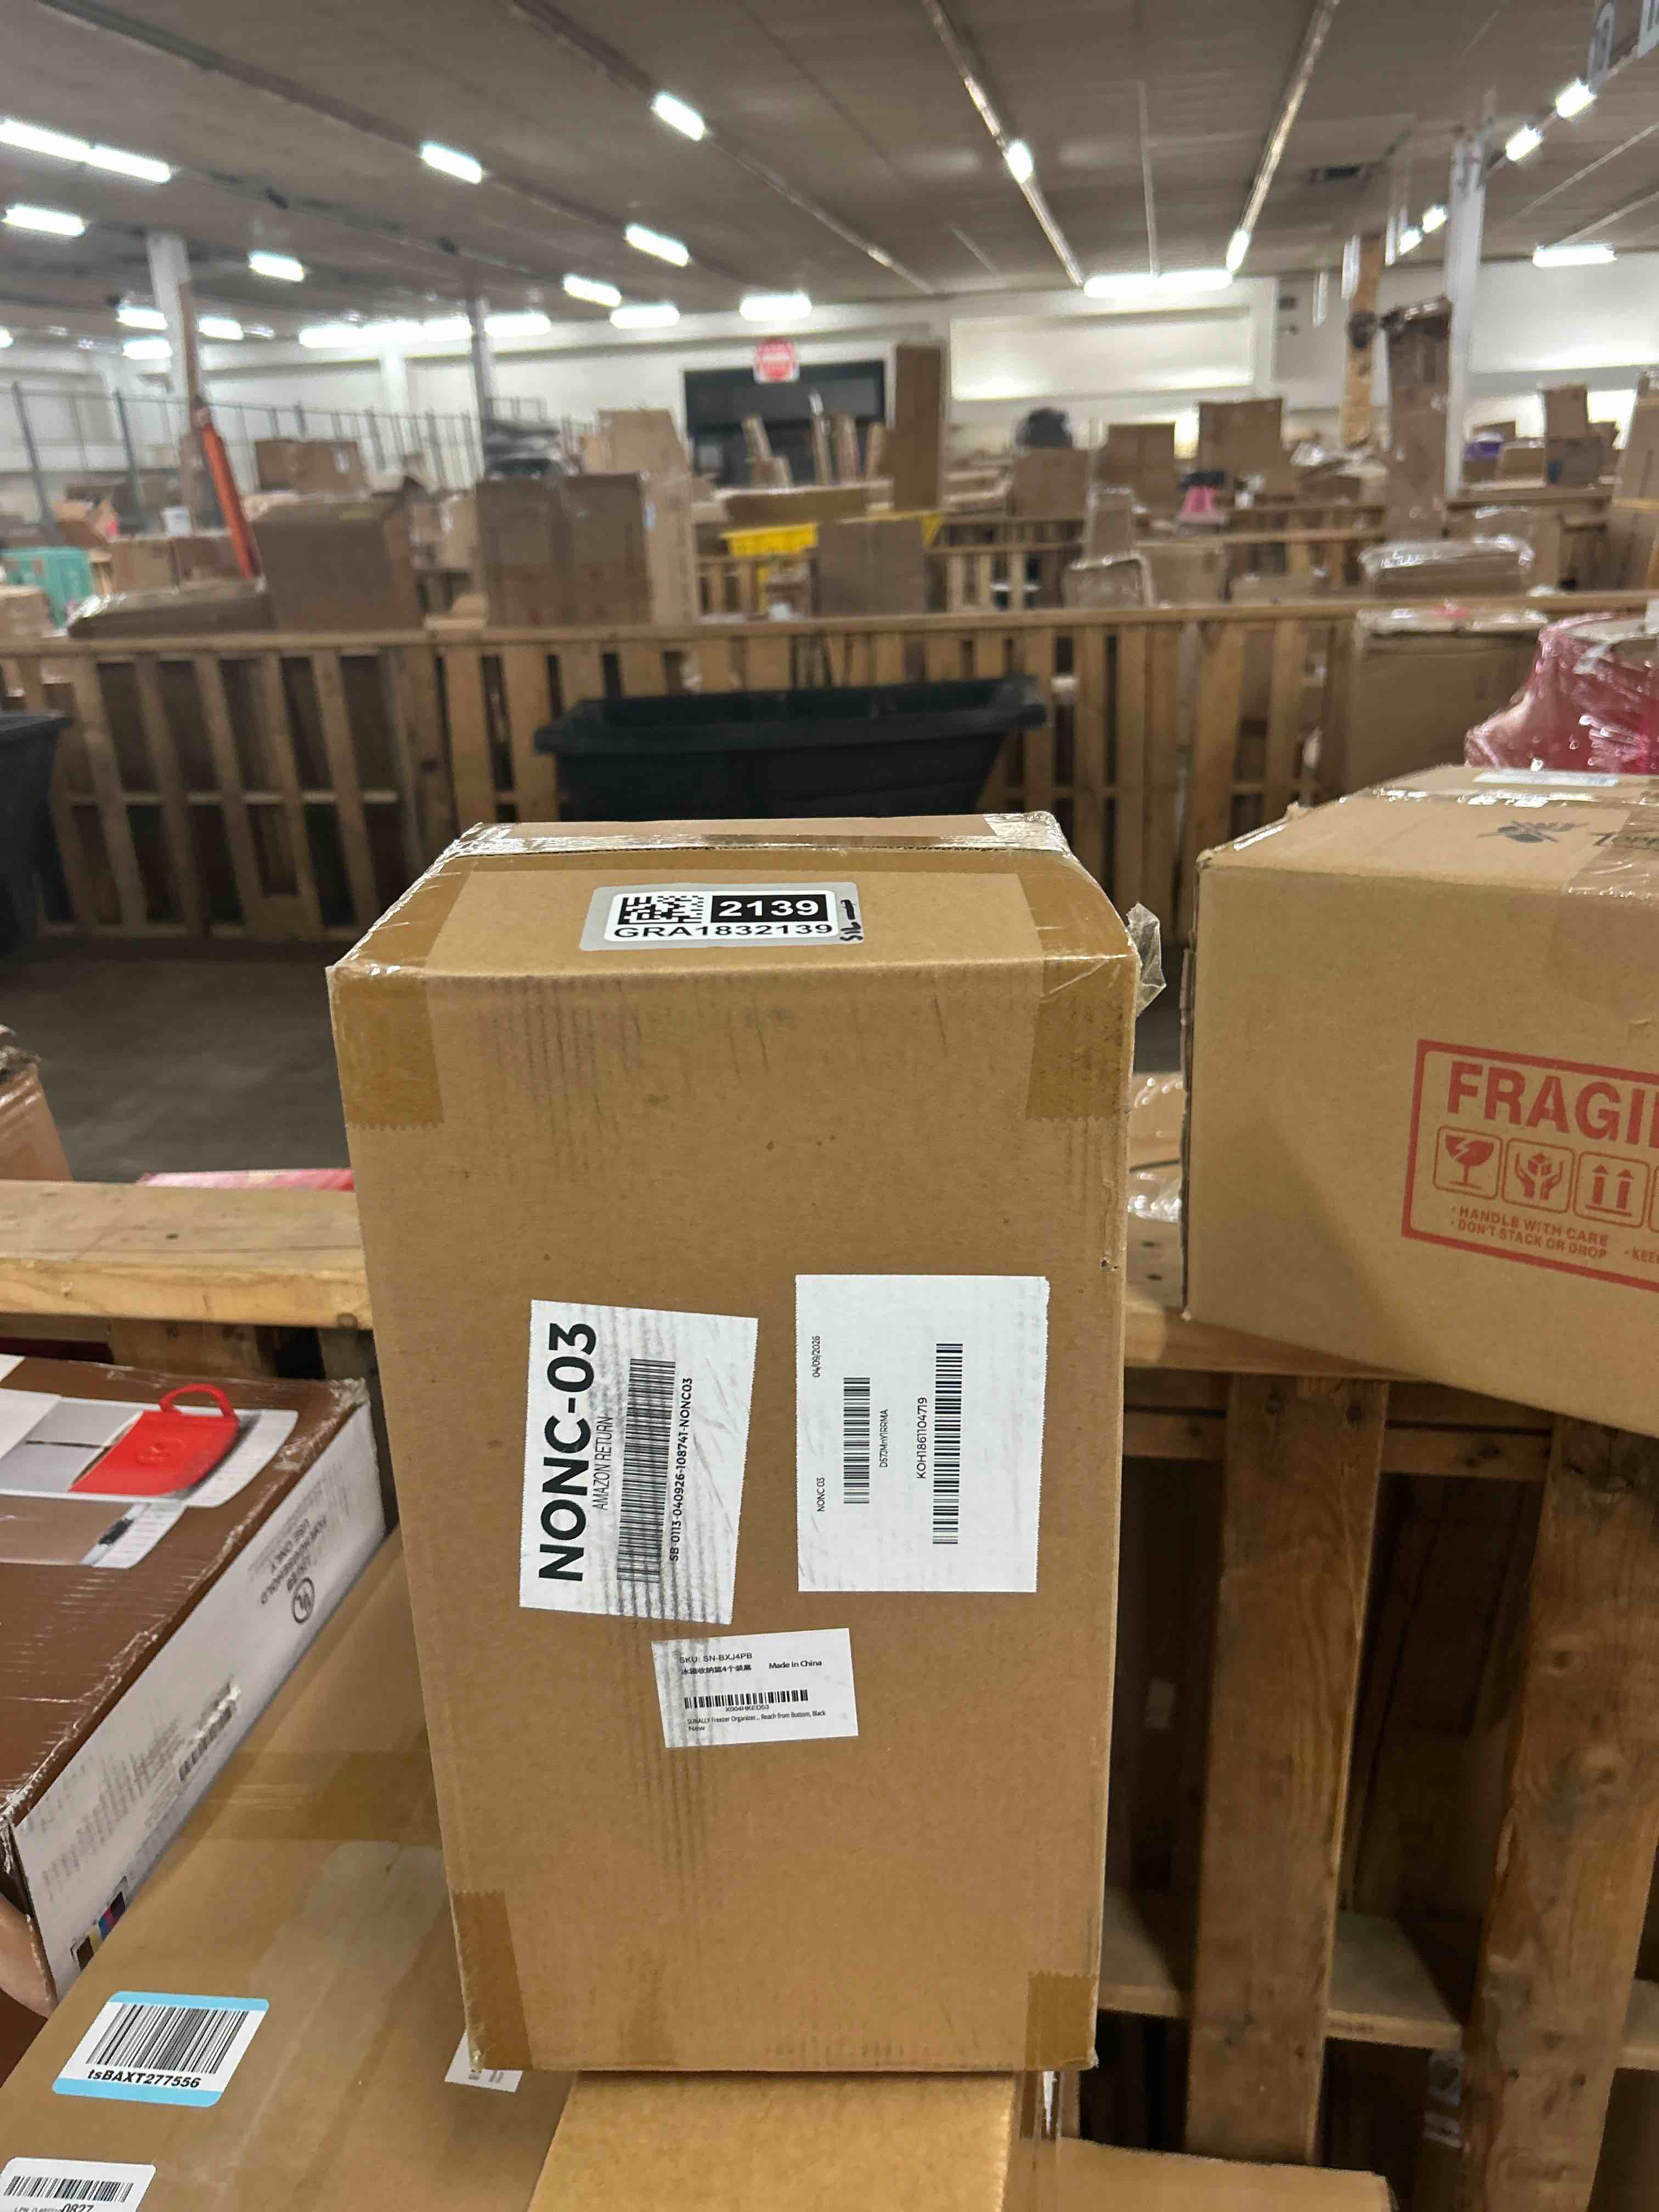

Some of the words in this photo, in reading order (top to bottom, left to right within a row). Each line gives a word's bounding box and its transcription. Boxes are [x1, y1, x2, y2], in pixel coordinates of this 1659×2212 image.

[718, 899, 820, 918] 2139
[614, 924, 833, 938] GRA1832139
[1458, 1220, 1495, 1237] DON'T
[1500, 1228, 1542, 1247] STACK
[1546, 1238, 1565, 1250] OR
[1569, 1243, 1607, 1259] DROP
[1459, 1206, 1519, 1228] HANDLE
[1524, 1219, 1562, 1235] WITH
[1566, 1228, 1609, 1247] CARE
[812, 1335, 821, 1378] 04/09/2026
[539, 1323, 597, 1582] NONC-03
[594, 1416, 613, 1460] RETURN
[916, 1397, 928, 1479] KOH1861104719
[592, 1464, 611, 1510] AMAZON
[669, 1378, 693, 1562] SB-0113-040926-108741-NONC03
[703, 1652, 753, 1662] SN-BXJ4PB
[769, 1661, 790, 1669] Made
[88, 2069, 201, 2088] tsBAXT277556
